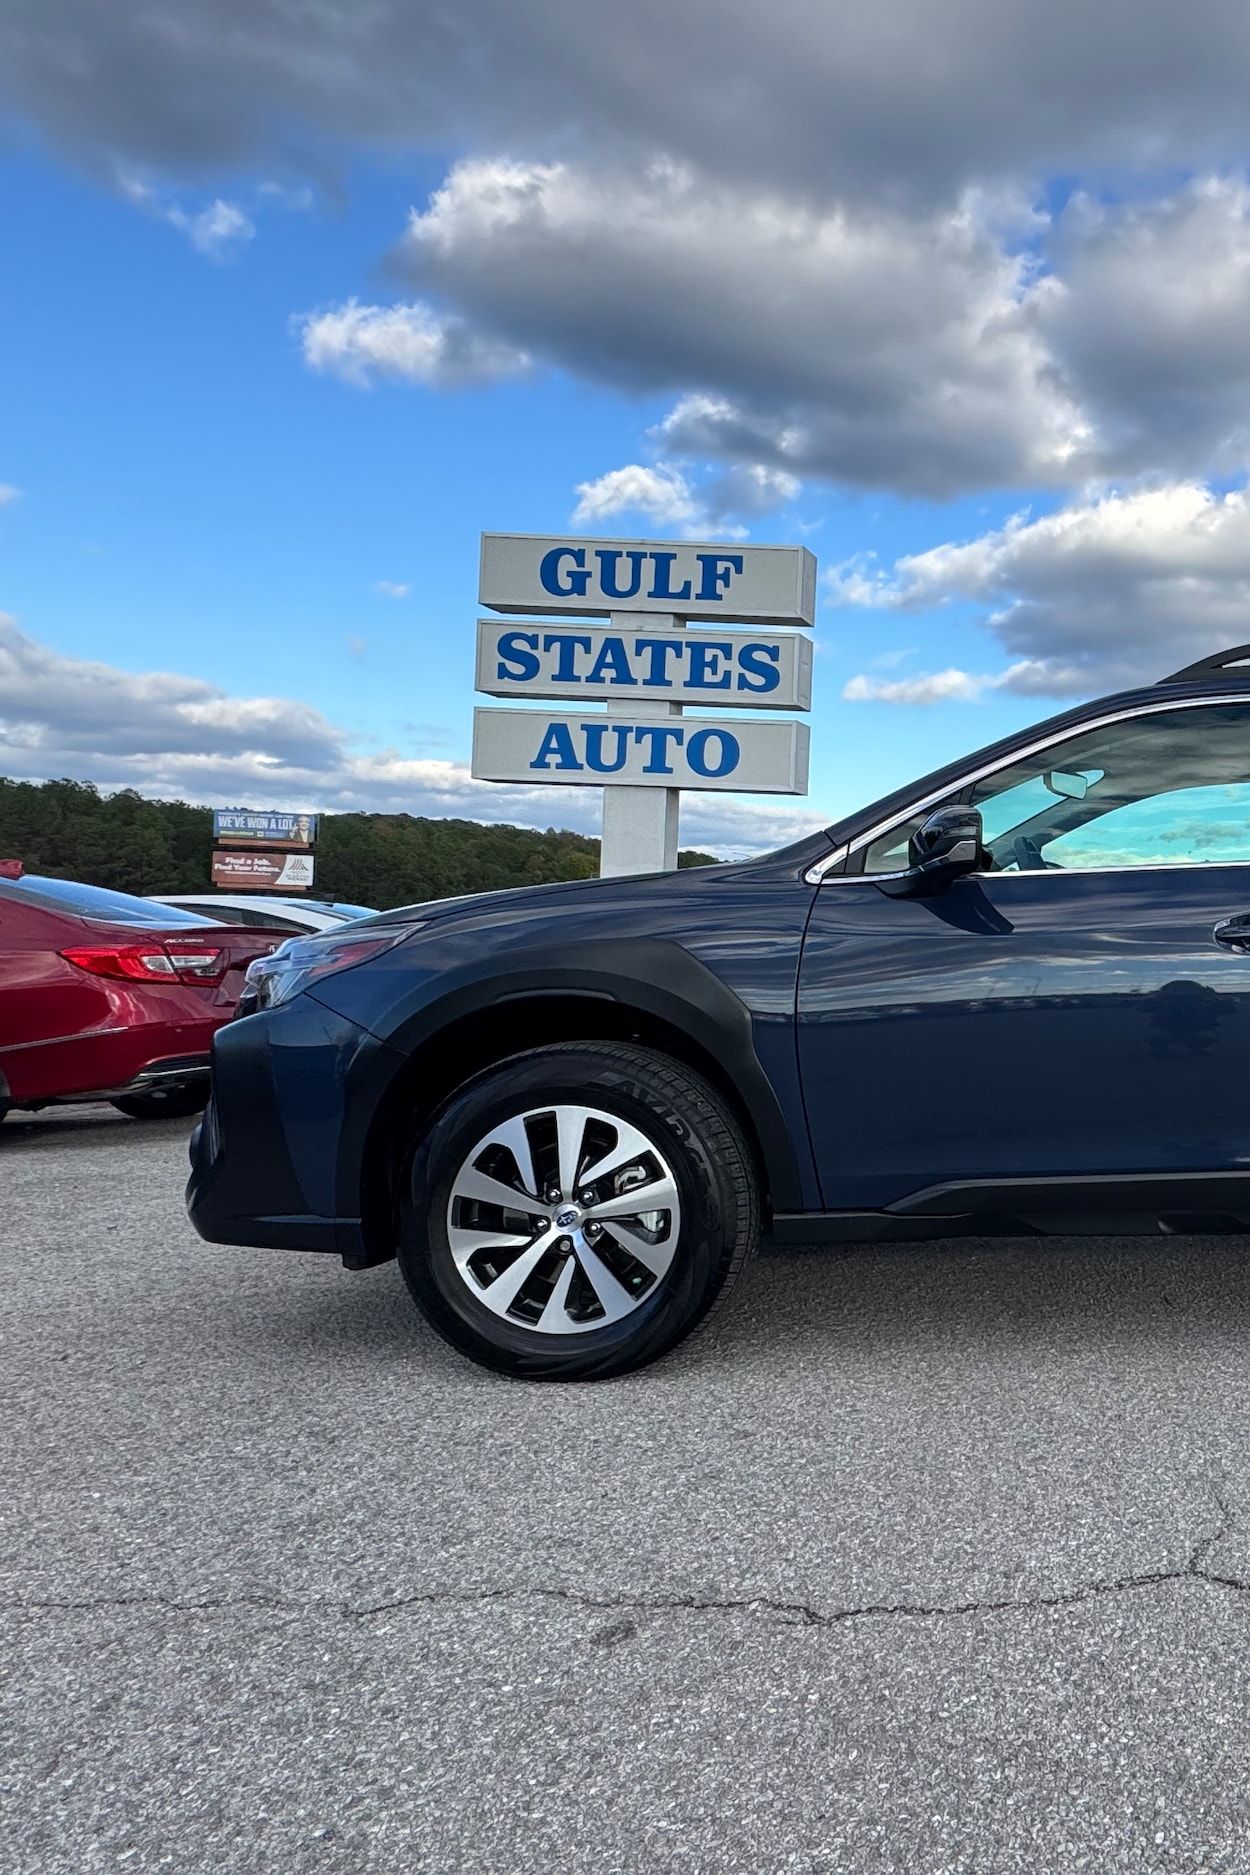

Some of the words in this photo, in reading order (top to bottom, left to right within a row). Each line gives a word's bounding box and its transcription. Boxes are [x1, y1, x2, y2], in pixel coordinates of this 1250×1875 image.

[539, 547, 744, 601] GULF
[496, 632, 781, 693] STATES
[529, 723, 741, 778] AUTO
[218, 816, 245, 828] WE'VE
[247, 817, 268, 829] WON
[270, 818, 277, 829] A
[214, 863, 233, 871] Find
